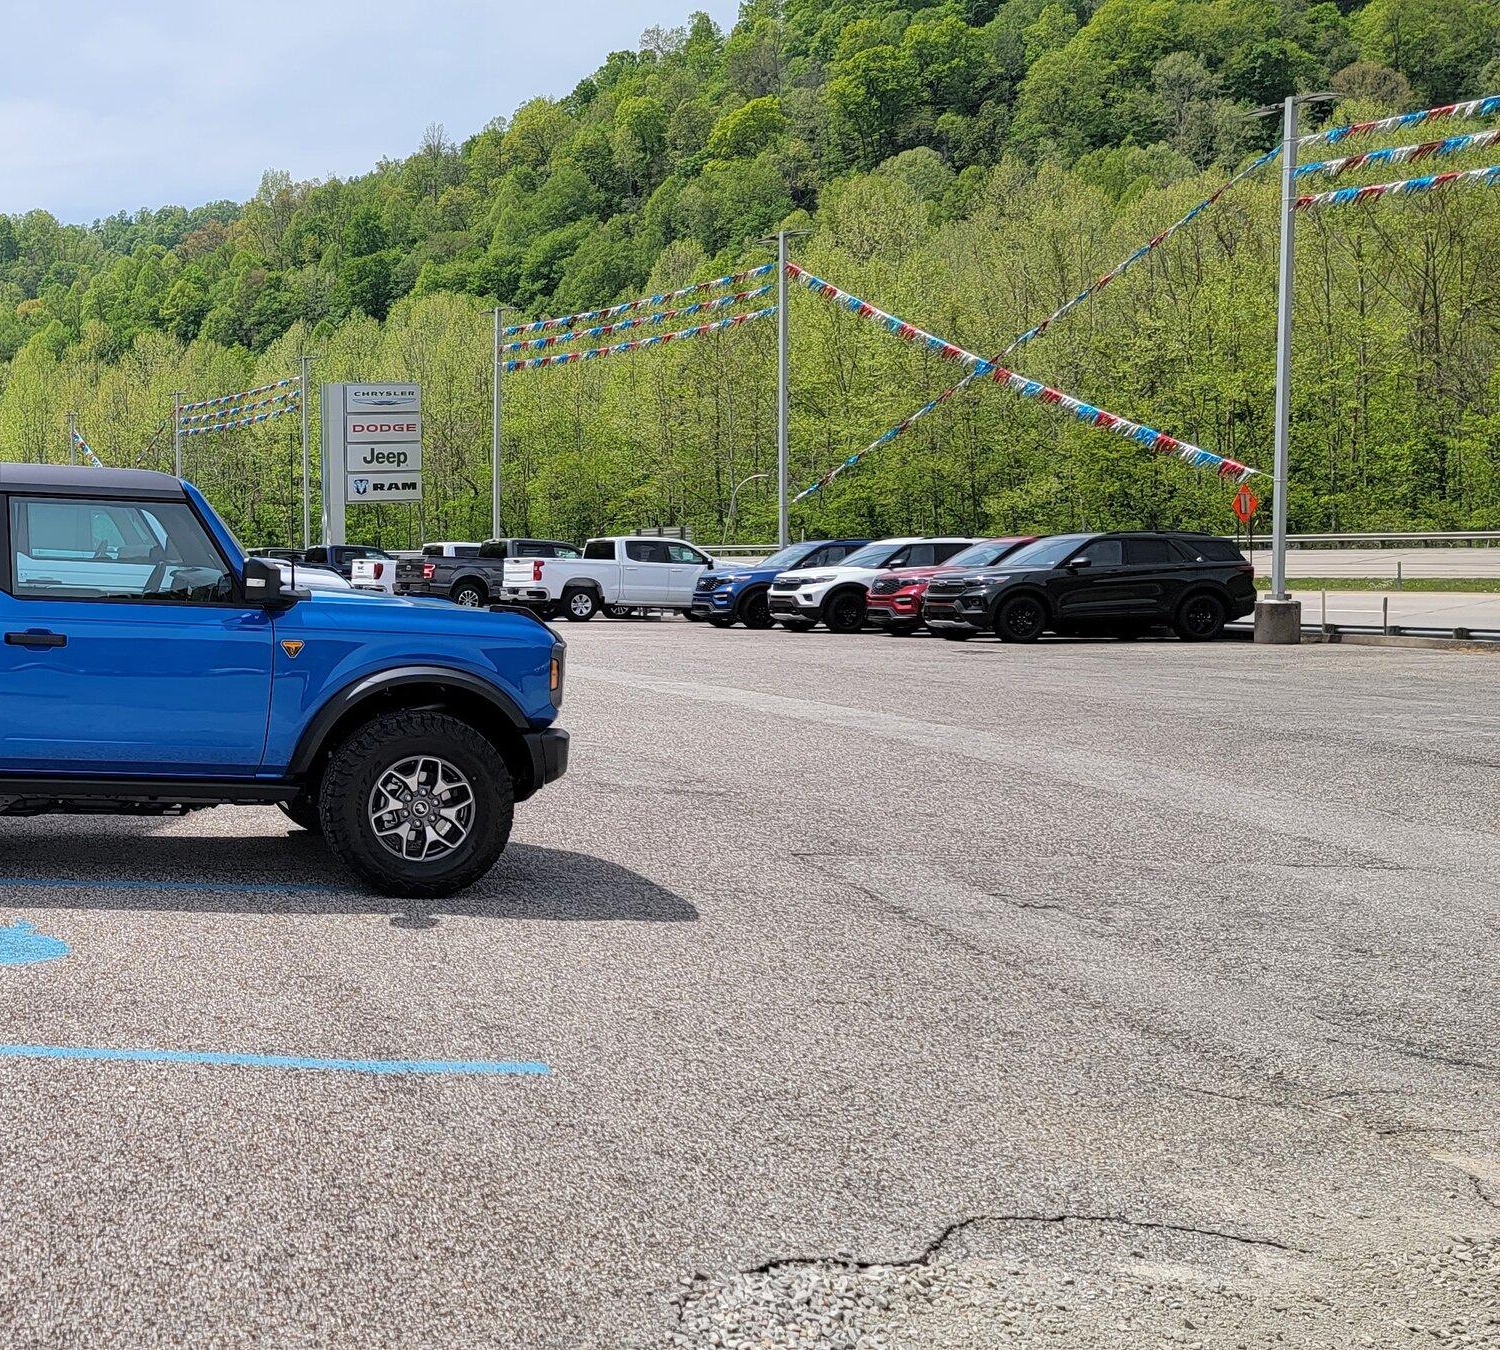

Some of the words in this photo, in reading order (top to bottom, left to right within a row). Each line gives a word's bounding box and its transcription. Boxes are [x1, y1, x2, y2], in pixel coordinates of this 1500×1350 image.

[353, 424, 416, 432] DODGE
[362, 447, 408, 468] Jeep
[372, 482, 417, 491] RAM
